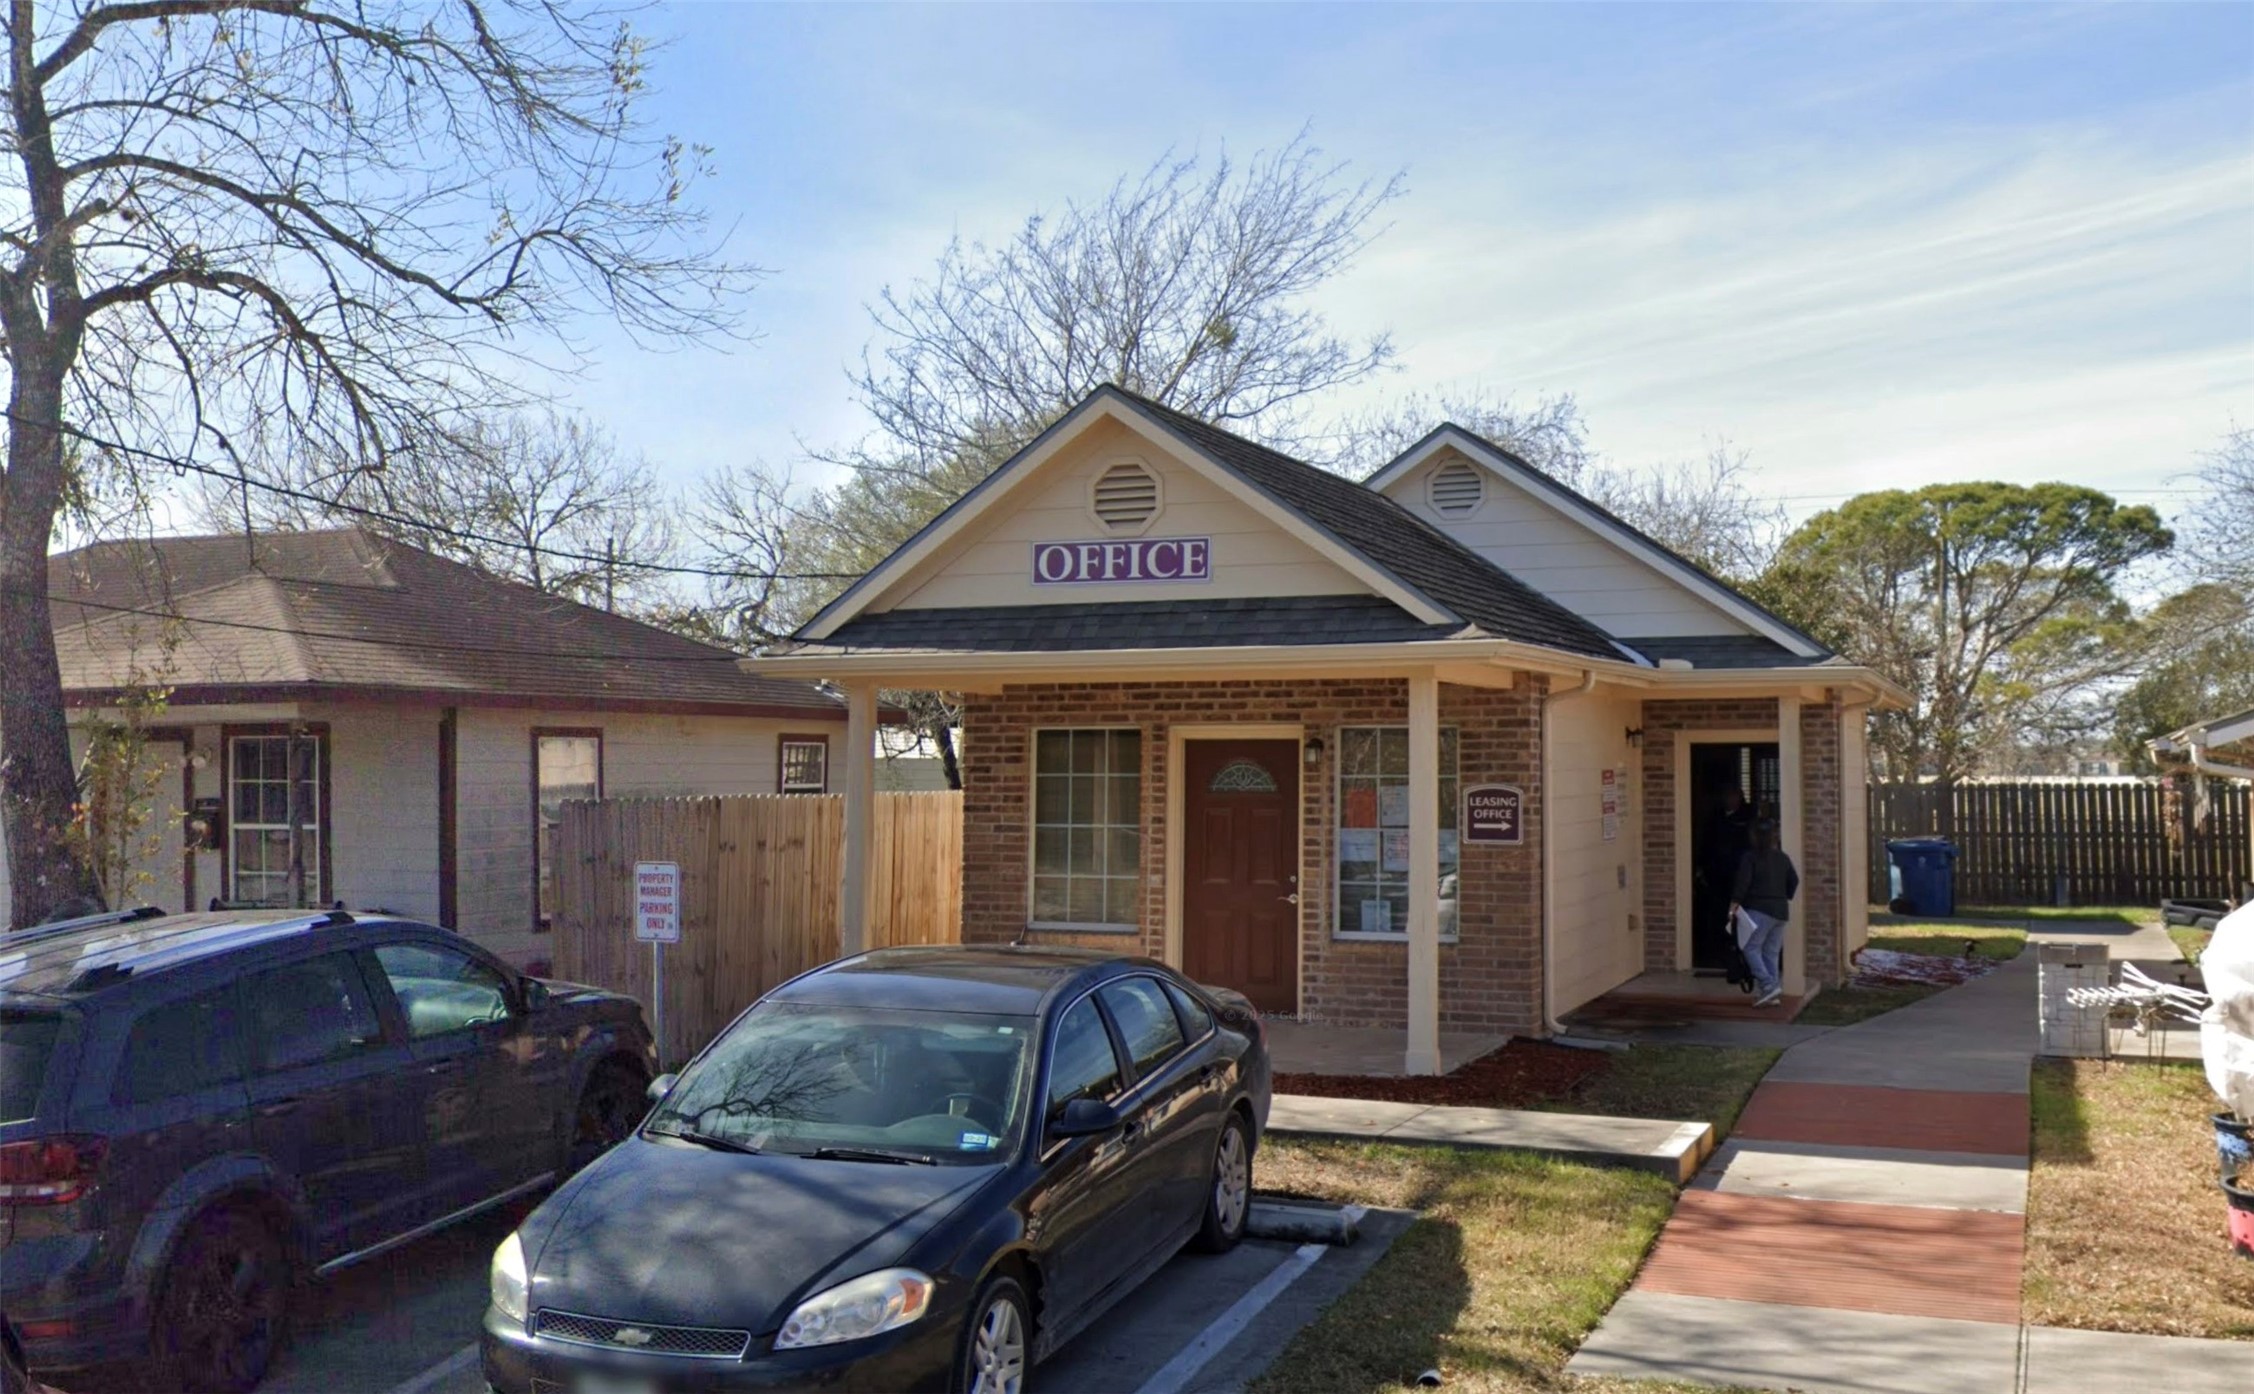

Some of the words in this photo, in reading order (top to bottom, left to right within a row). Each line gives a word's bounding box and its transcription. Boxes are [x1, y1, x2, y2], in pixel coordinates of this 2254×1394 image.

[1038, 541, 1206, 581] OFFICE
[1469, 796, 1517, 807] LEASING
[1473, 809, 1513, 819] OFFICE
[638, 873, 674, 884] PROPERTY
[640, 886, 672, 897] MANAGER
[639, 902, 673, 915] PARKING
[646, 917, 665, 930] ONLY
